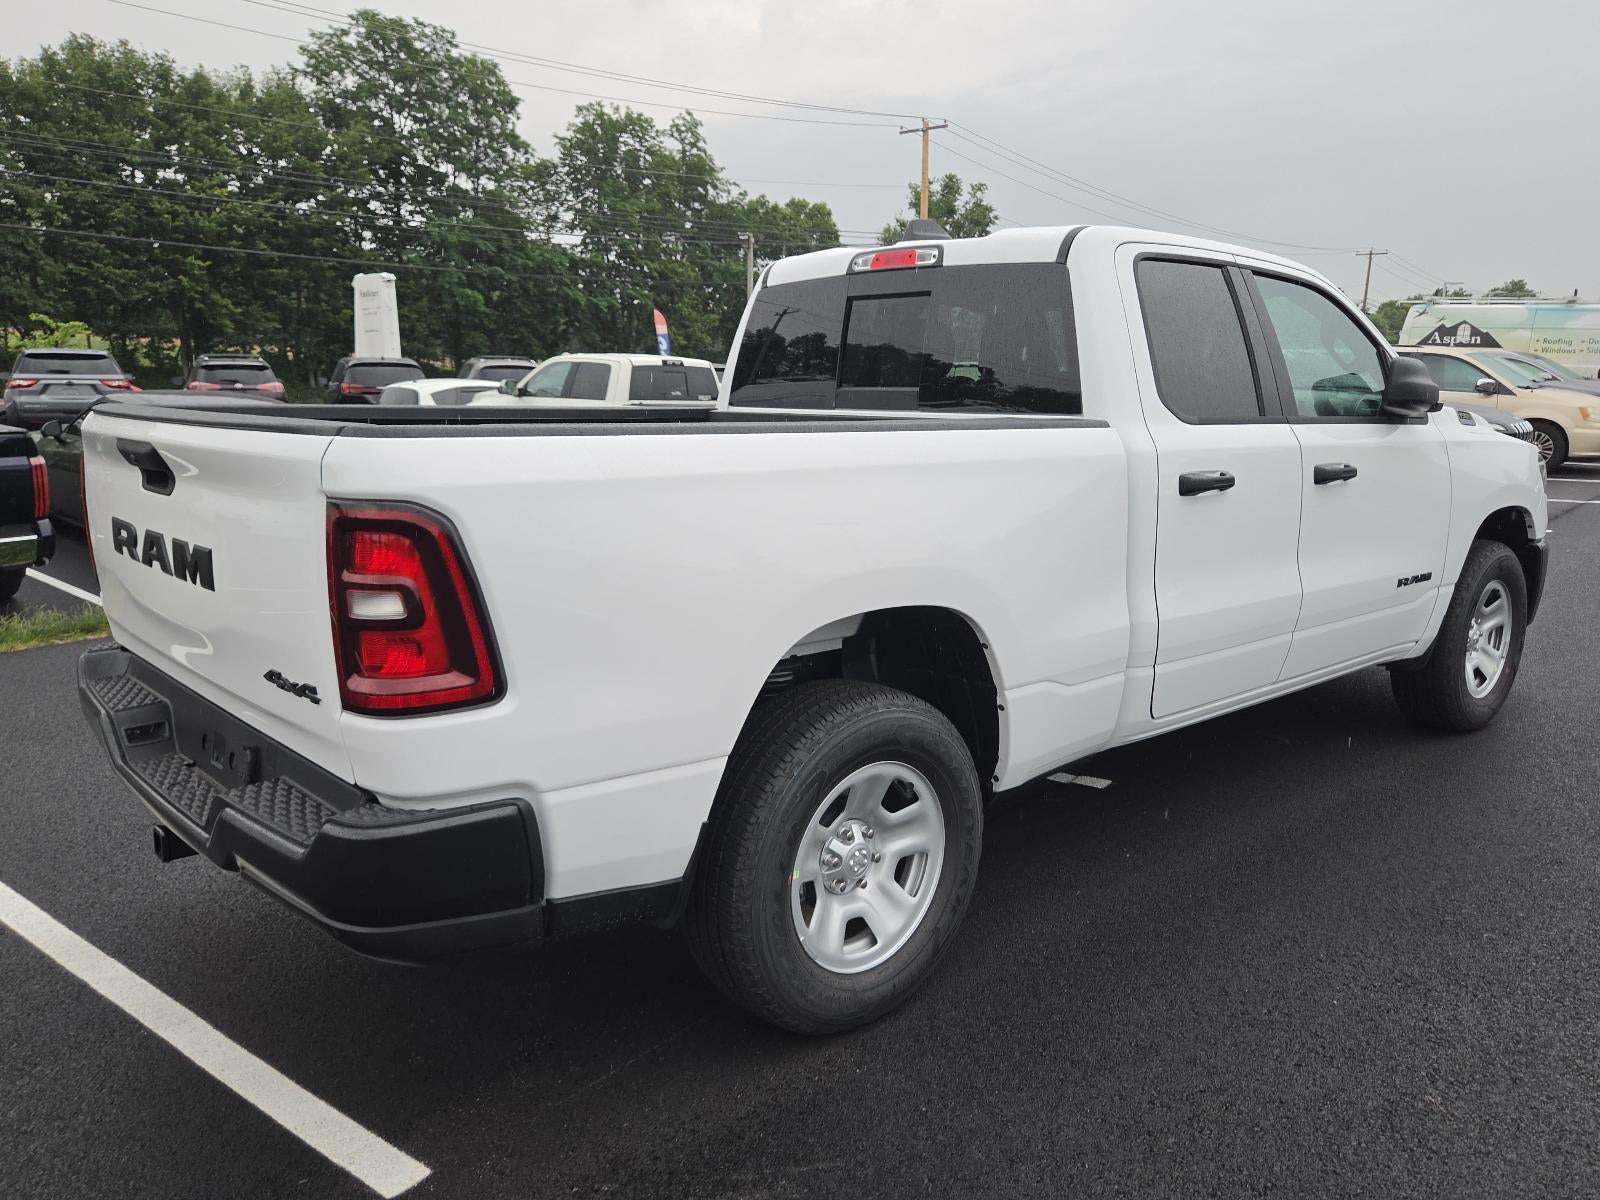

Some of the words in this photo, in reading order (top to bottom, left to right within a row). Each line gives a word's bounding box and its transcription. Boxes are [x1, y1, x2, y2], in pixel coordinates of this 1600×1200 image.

[1428, 331, 1481, 347] Aspen
[1543, 338, 1573, 347] Roofing
[1541, 346, 1576, 354] Windows
[111, 516, 216, 592] RAM
[1396, 571, 1432, 588] RAM
